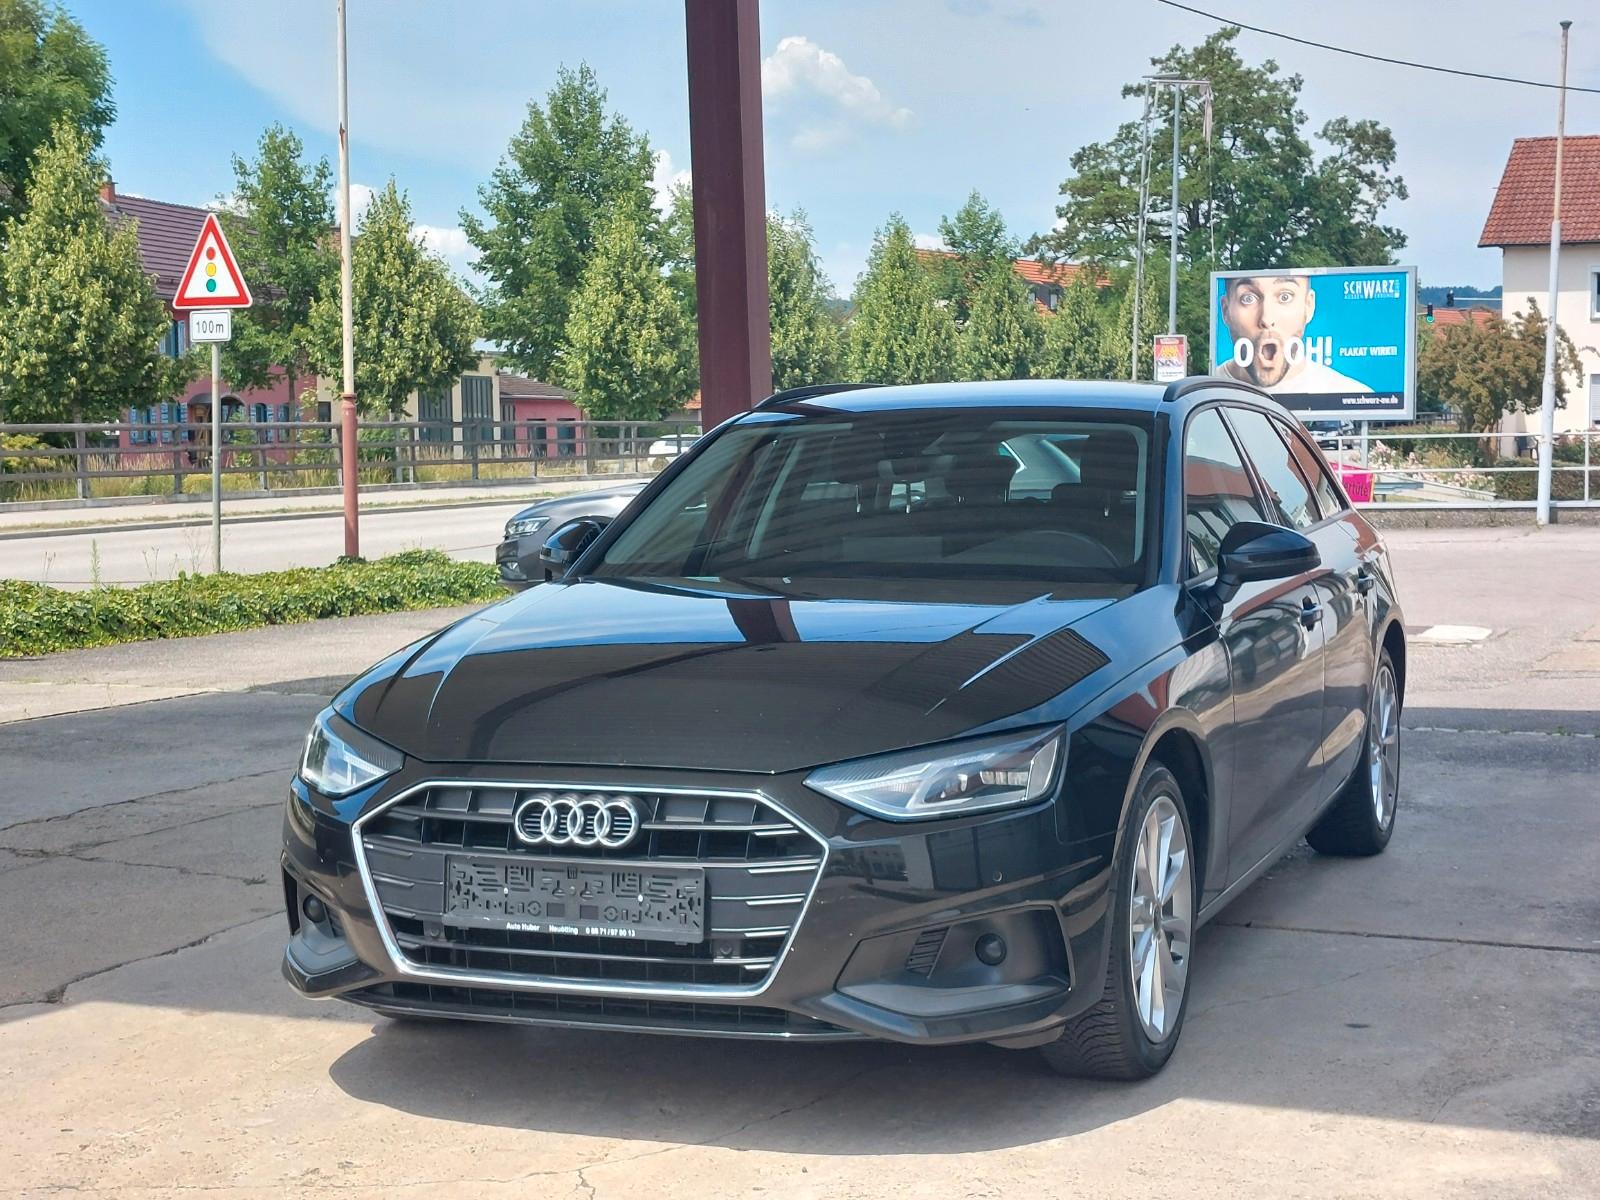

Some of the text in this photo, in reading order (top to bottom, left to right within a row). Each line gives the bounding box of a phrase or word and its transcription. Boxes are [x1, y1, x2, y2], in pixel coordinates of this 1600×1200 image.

[1343, 279, 1395, 299] SCHWARZ
[196, 320, 224, 334] 100m
[1339, 346, 1368, 357] PLAKAT
[506, 922, 521, 930] Auto
[521, 923, 540, 931] Huber
